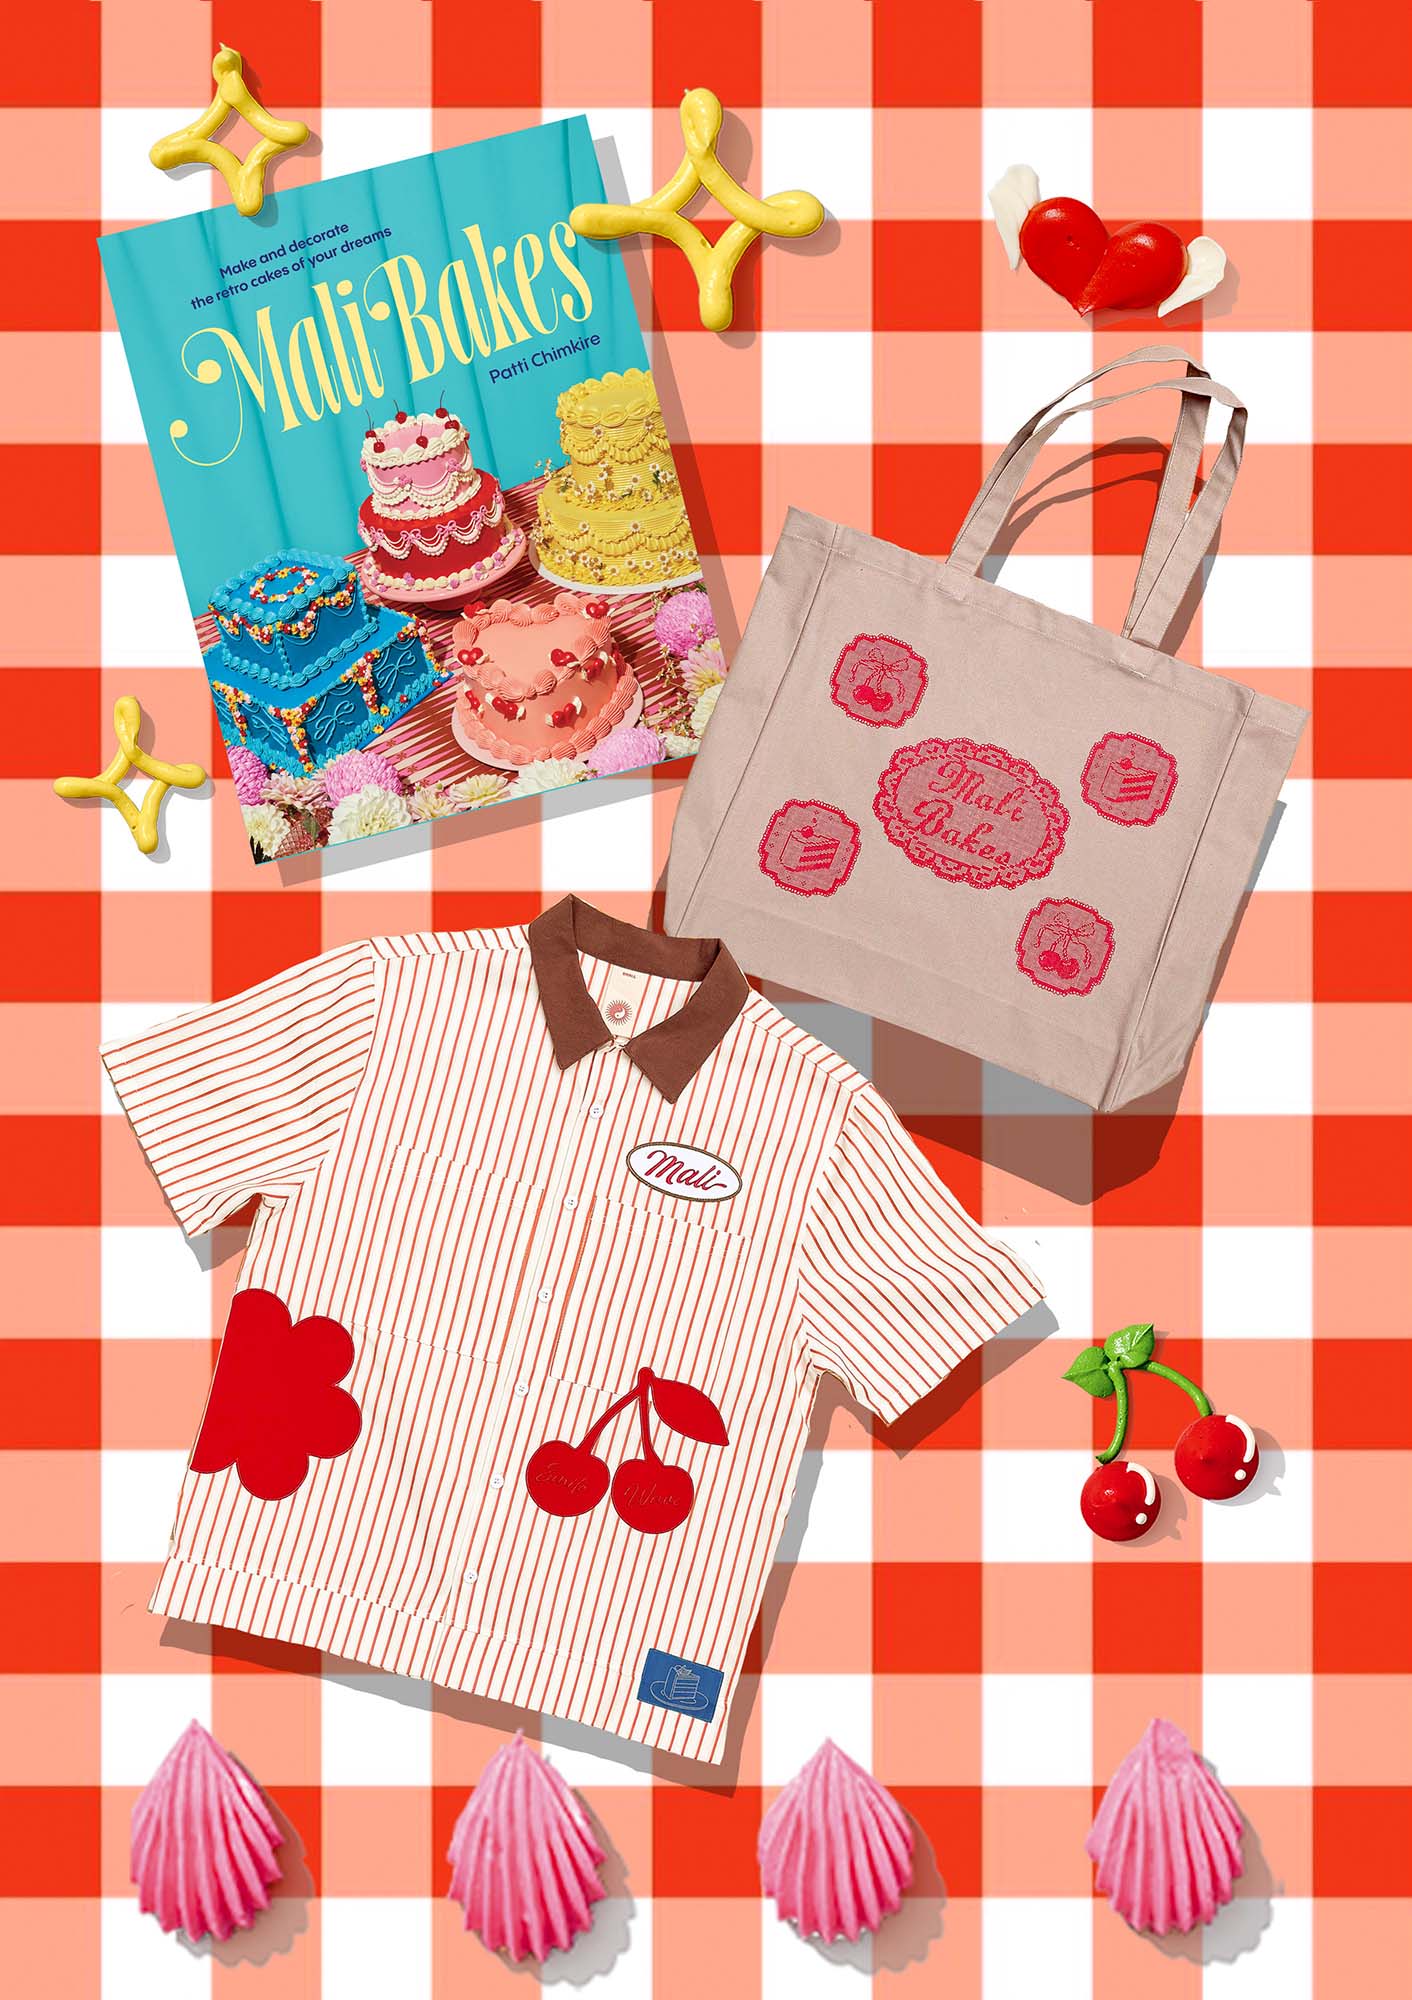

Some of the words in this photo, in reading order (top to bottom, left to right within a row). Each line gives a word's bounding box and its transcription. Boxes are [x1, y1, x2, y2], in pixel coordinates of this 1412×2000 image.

[190, 295, 214, 310] the
[215, 282, 249, 301] retro
[250, 266, 290, 288] cakes
[291, 256, 305, 272] of
[307, 247, 338, 269] your
[340, 227, 393, 253] dreams
[218, 258, 257, 280] Make
[259, 244, 287, 264] and
[288, 223, 350, 252] decorate
[169, 279, 385, 467] Mali
[363, 222, 594, 385] Bakes
[488, 357, 530, 385] Patti
[531, 334, 601, 368] Chimkire
[927, 760, 1028, 822] Mali
[644, 1150, 728, 1190] Mali
